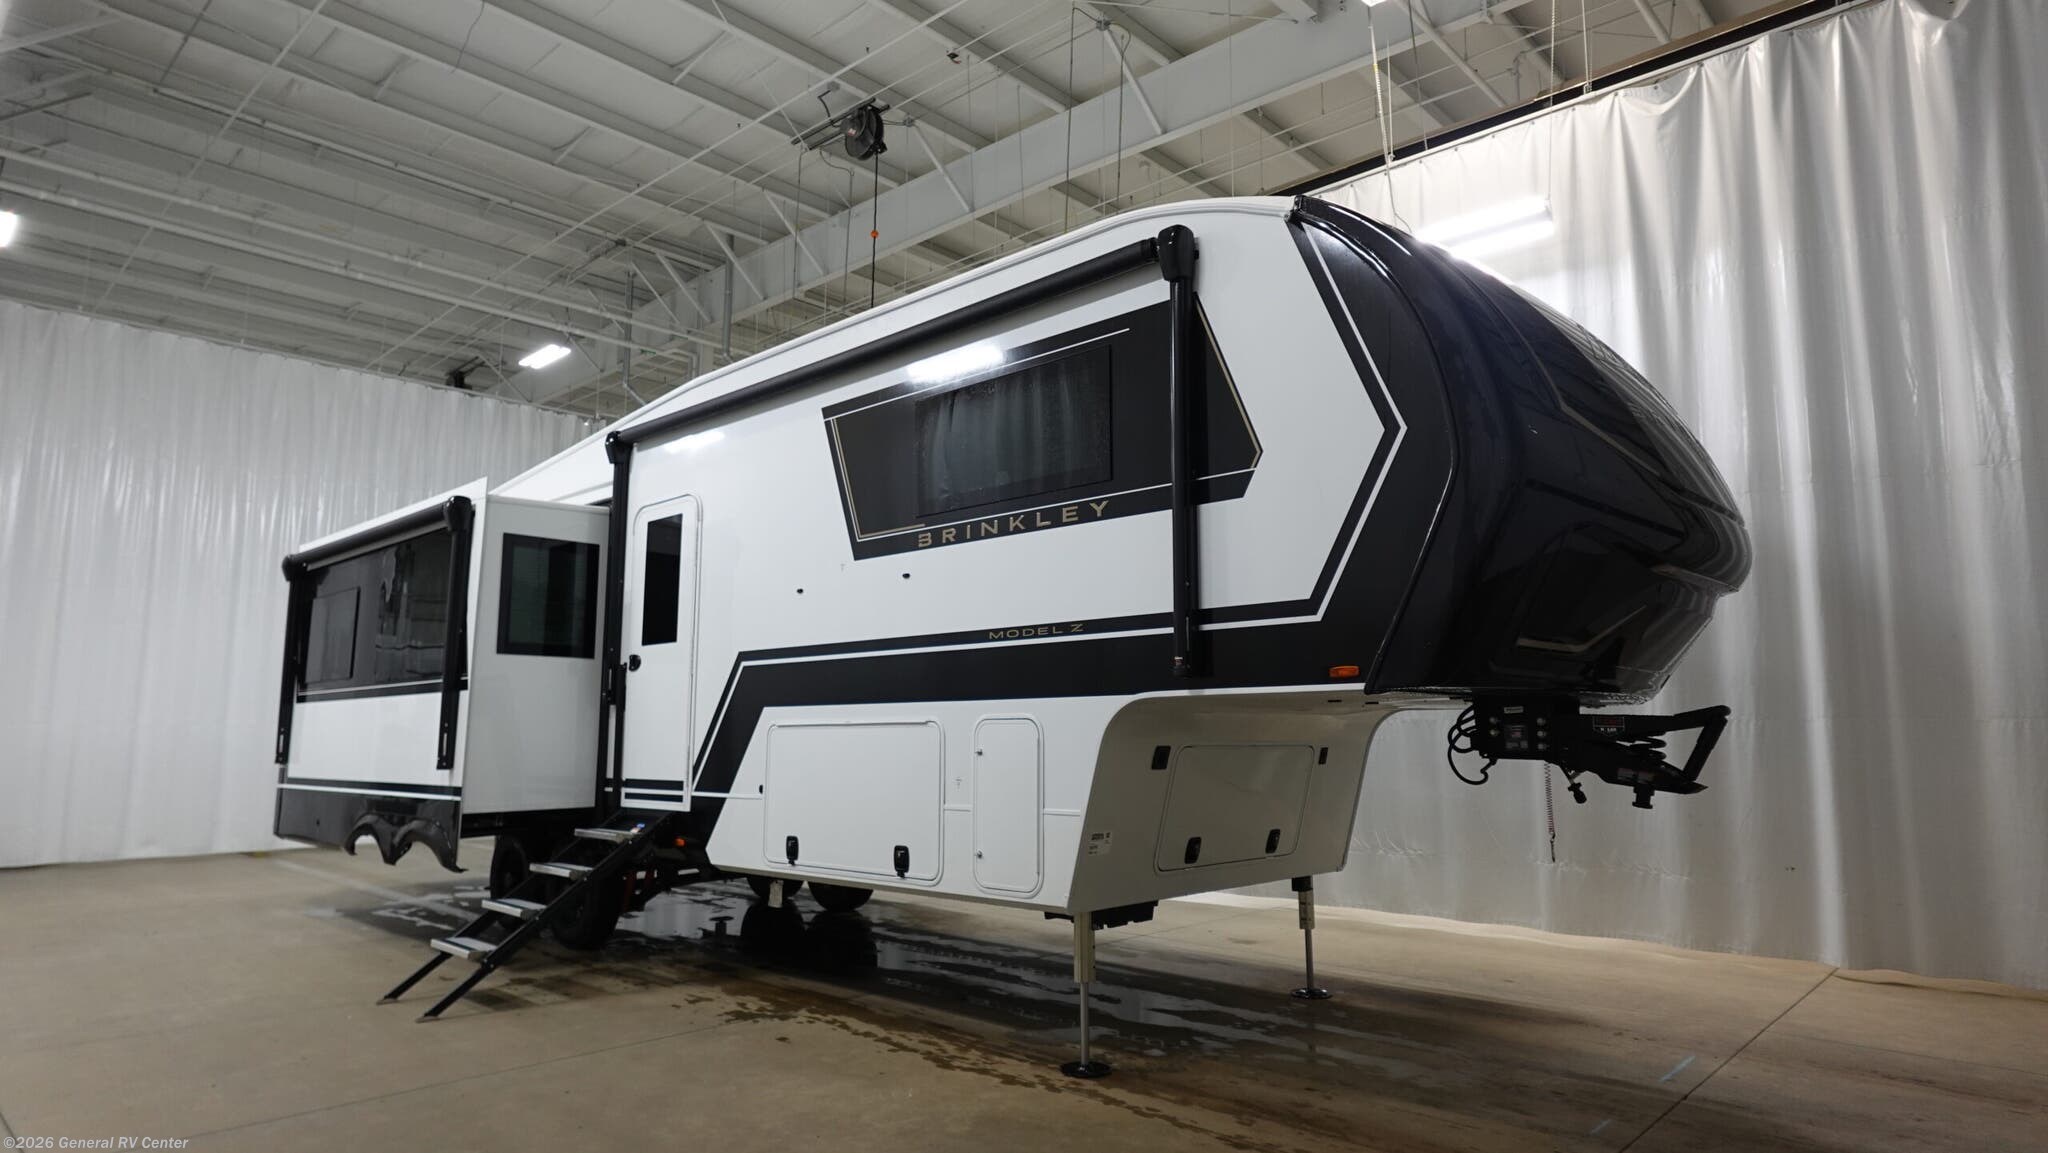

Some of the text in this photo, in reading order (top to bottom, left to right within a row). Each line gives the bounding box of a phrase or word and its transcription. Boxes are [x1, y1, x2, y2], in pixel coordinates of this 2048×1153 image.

[918, 500, 1109, 548] BRINKLEY
[988, 623, 1084, 640] MODEL Z
